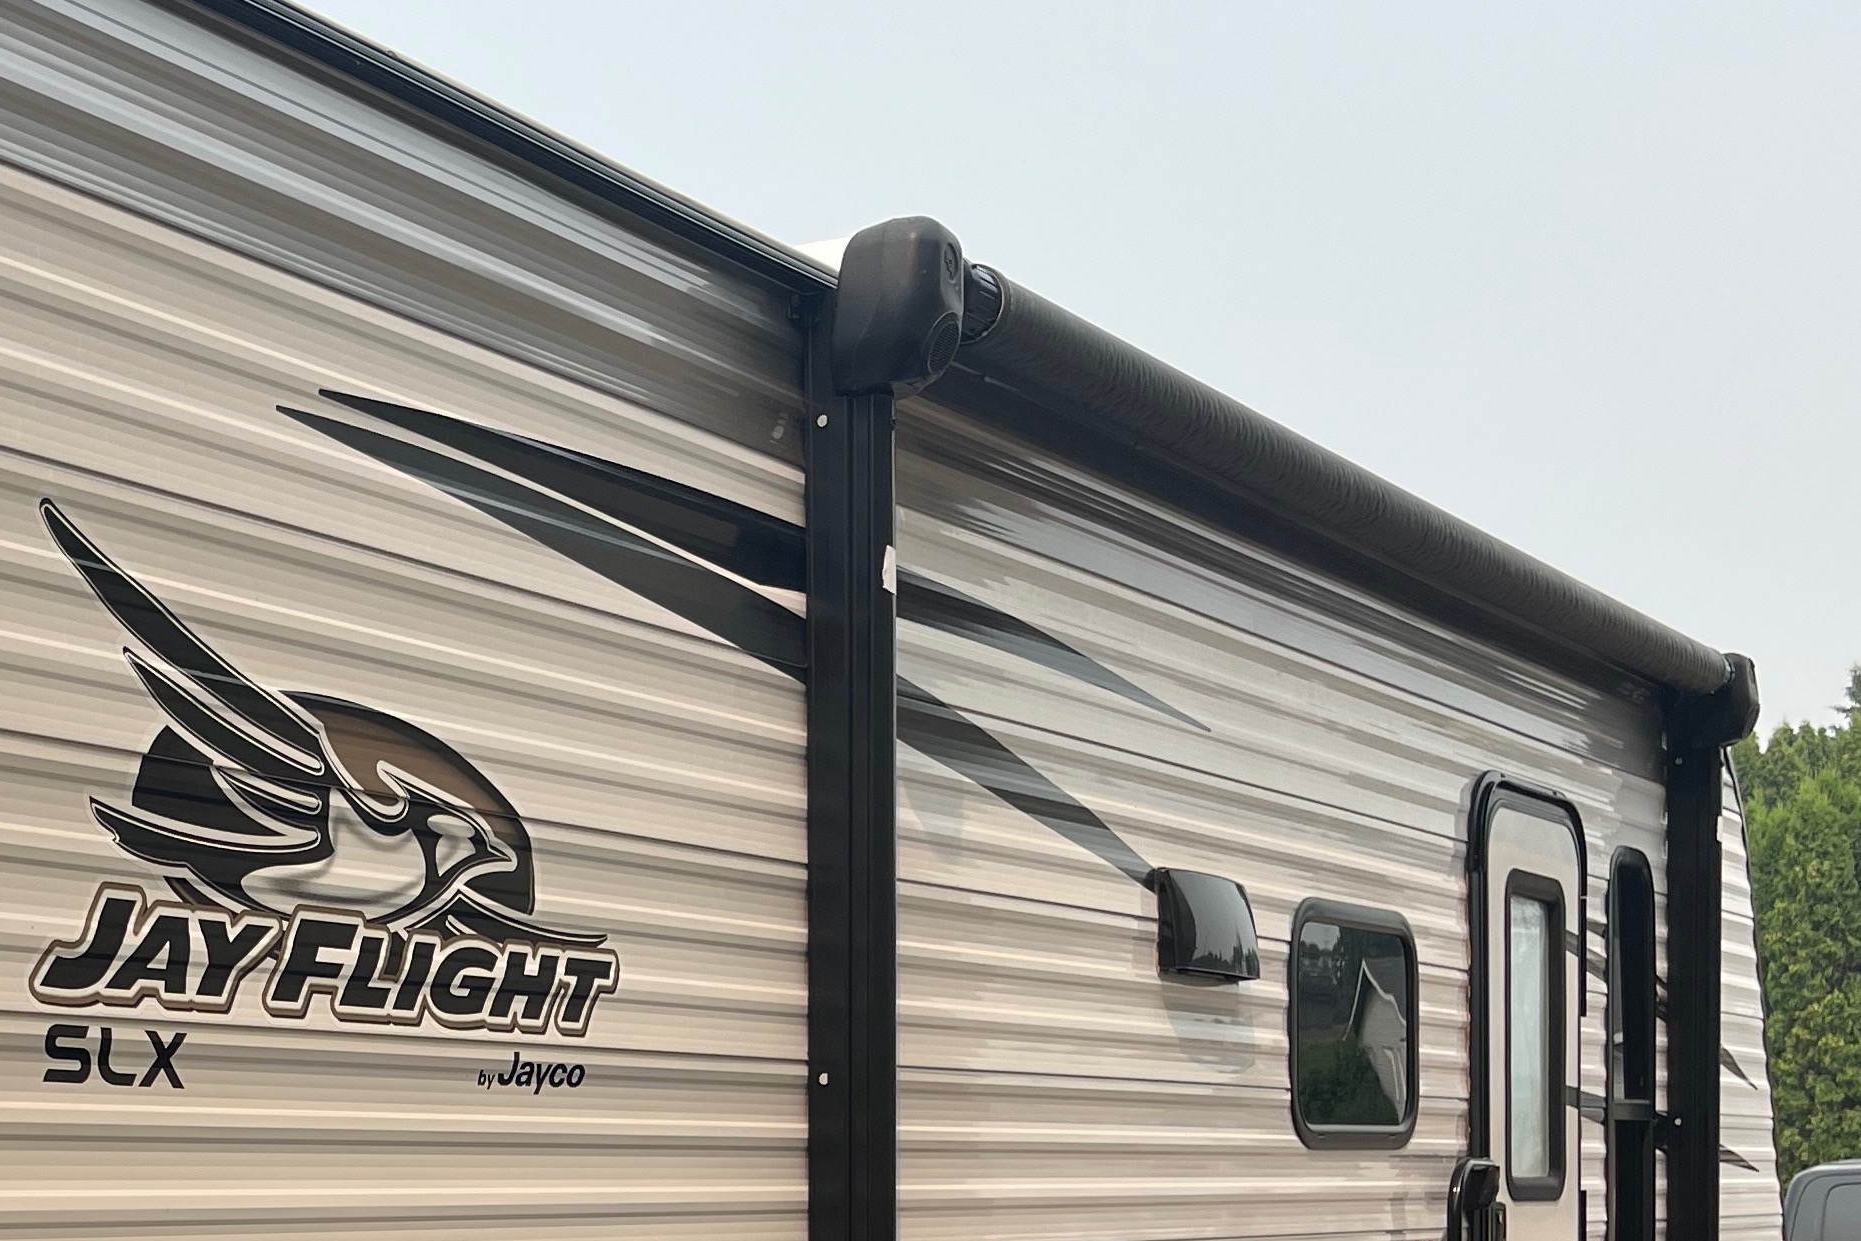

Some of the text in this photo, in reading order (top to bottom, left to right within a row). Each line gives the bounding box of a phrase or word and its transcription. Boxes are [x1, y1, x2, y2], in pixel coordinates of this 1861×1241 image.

[29, 882, 620, 1037] JAY FLIGHT
[42, 1023, 187, 1090] SLX
[477, 1051, 586, 1096] by Jayco
